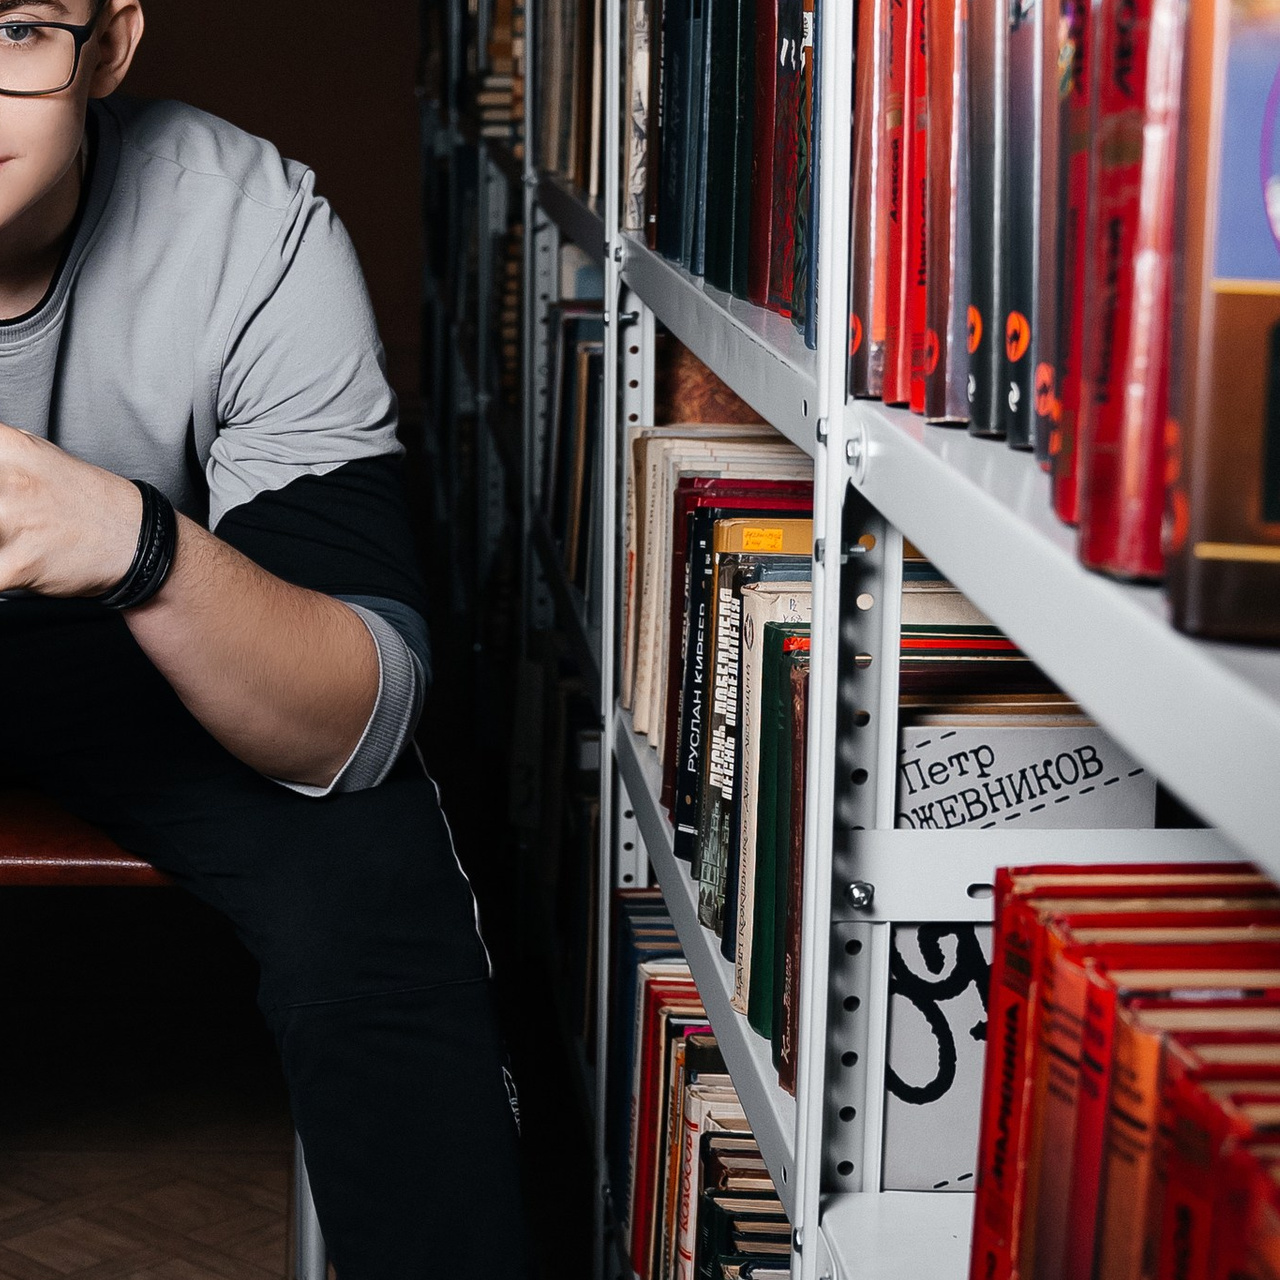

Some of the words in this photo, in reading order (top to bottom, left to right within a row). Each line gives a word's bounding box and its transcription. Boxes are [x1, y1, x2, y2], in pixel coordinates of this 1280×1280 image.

[687, 690, 702, 773] РУСЛАН
[709, 725, 726, 789] ПЕСНЬ
[896, 745, 1104, 829] ЖЕВНИКОВ
[900, 744, 996, 795] Петр
